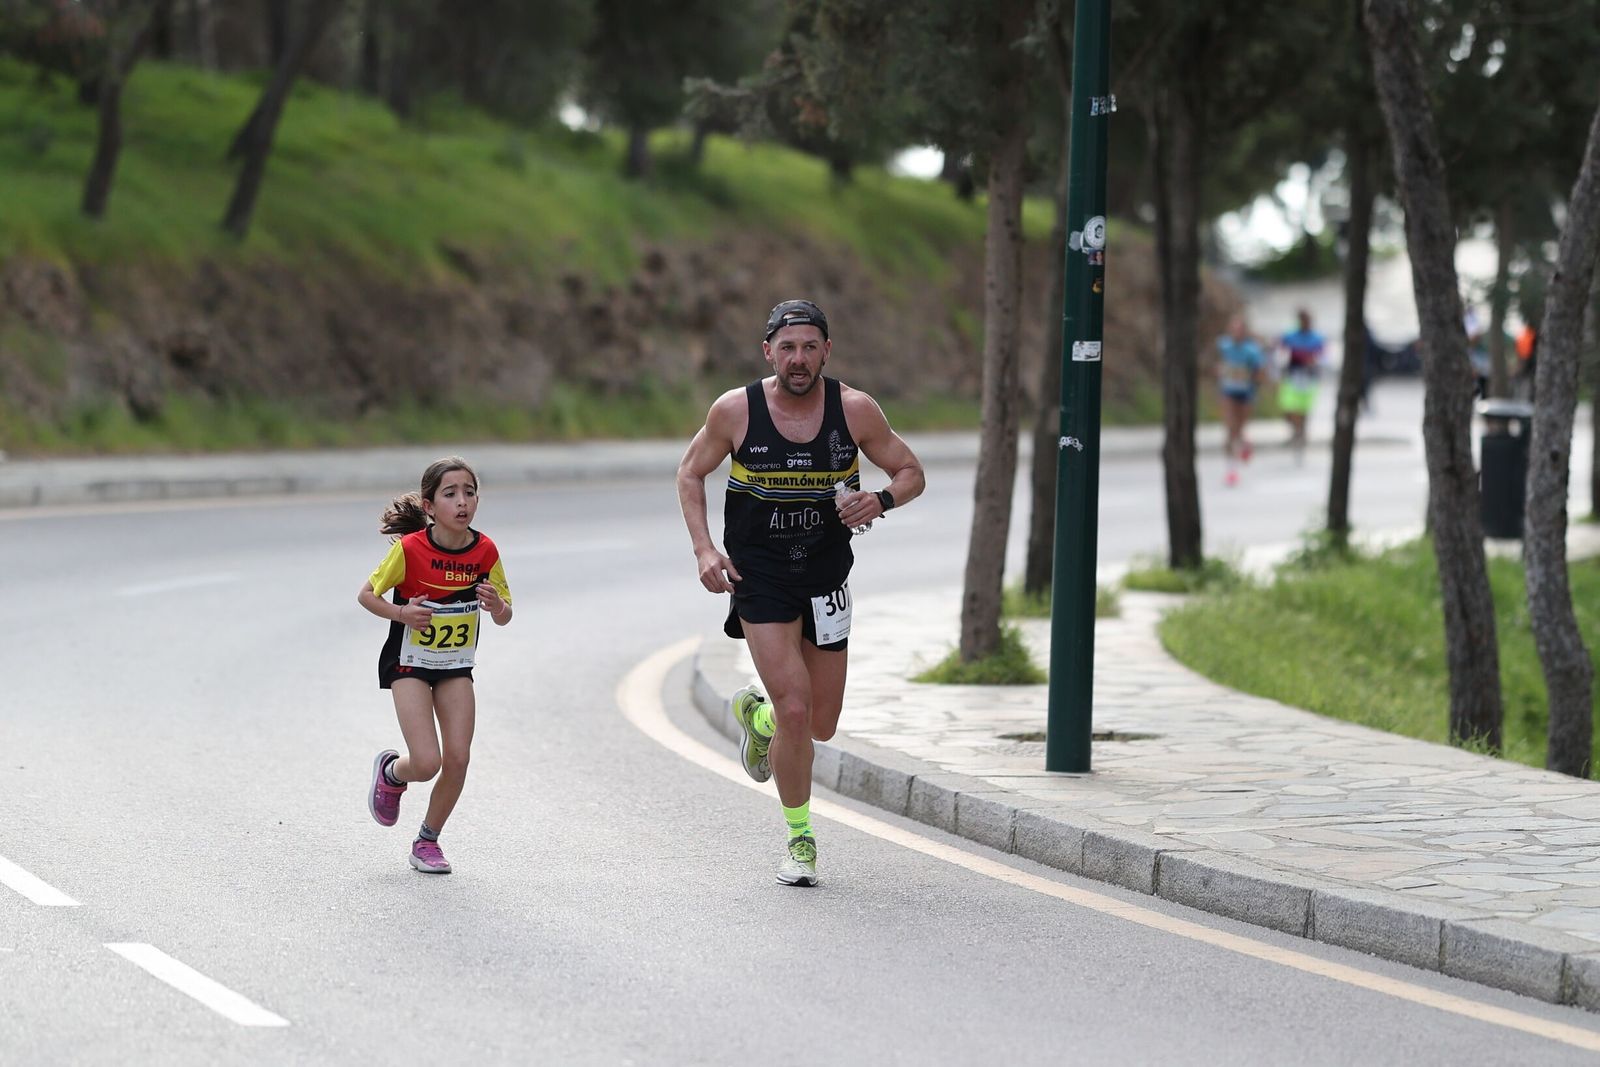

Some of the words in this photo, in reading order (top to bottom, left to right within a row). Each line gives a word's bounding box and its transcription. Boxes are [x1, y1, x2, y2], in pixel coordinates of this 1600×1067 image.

[749, 445, 769, 453] vive
[786, 459, 812, 468] gross
[747, 475, 766, 485] CLUB
[767, 474, 815, 486] TRIATLÓN
[431, 558, 480, 573] Málaga
[445, 571, 478, 582] Bahía
[419, 623, 469, 648] 923
